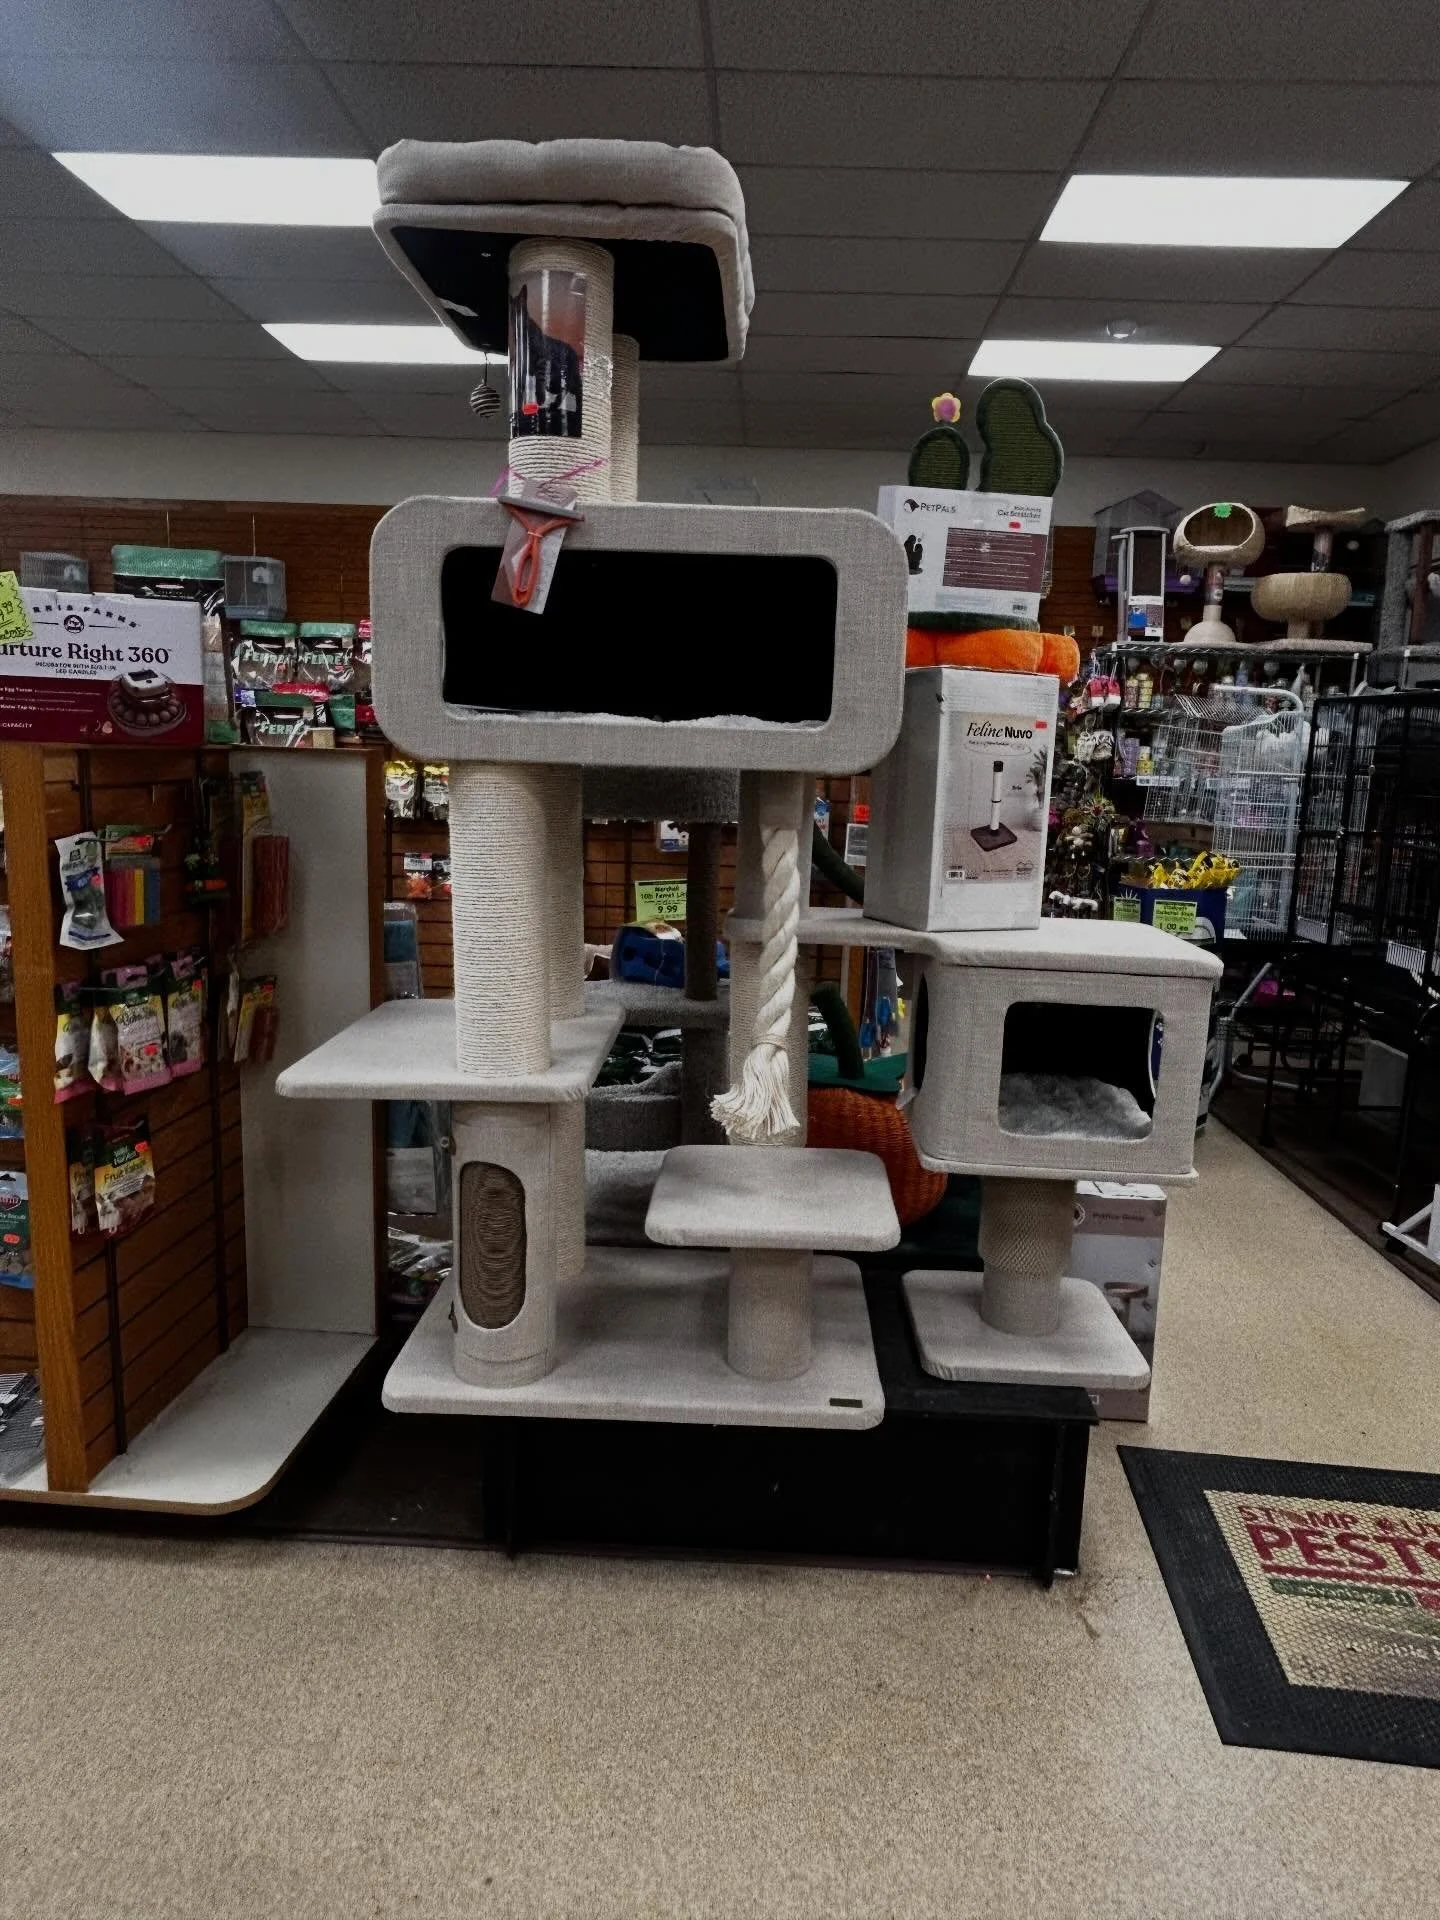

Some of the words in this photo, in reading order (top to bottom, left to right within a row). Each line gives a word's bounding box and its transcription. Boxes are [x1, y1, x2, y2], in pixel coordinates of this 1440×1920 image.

[920, 503, 957, 513] PETPALS
[32, 604, 74, 613] RRIS
[0, 641, 63, 658] urture
[67, 642, 124, 663] Right
[128, 646, 169, 664] 360
[967, 720, 1003, 738] Feline
[1004, 726, 1033, 740] Nuvo
[657, 905, 678, 914] 9.99
